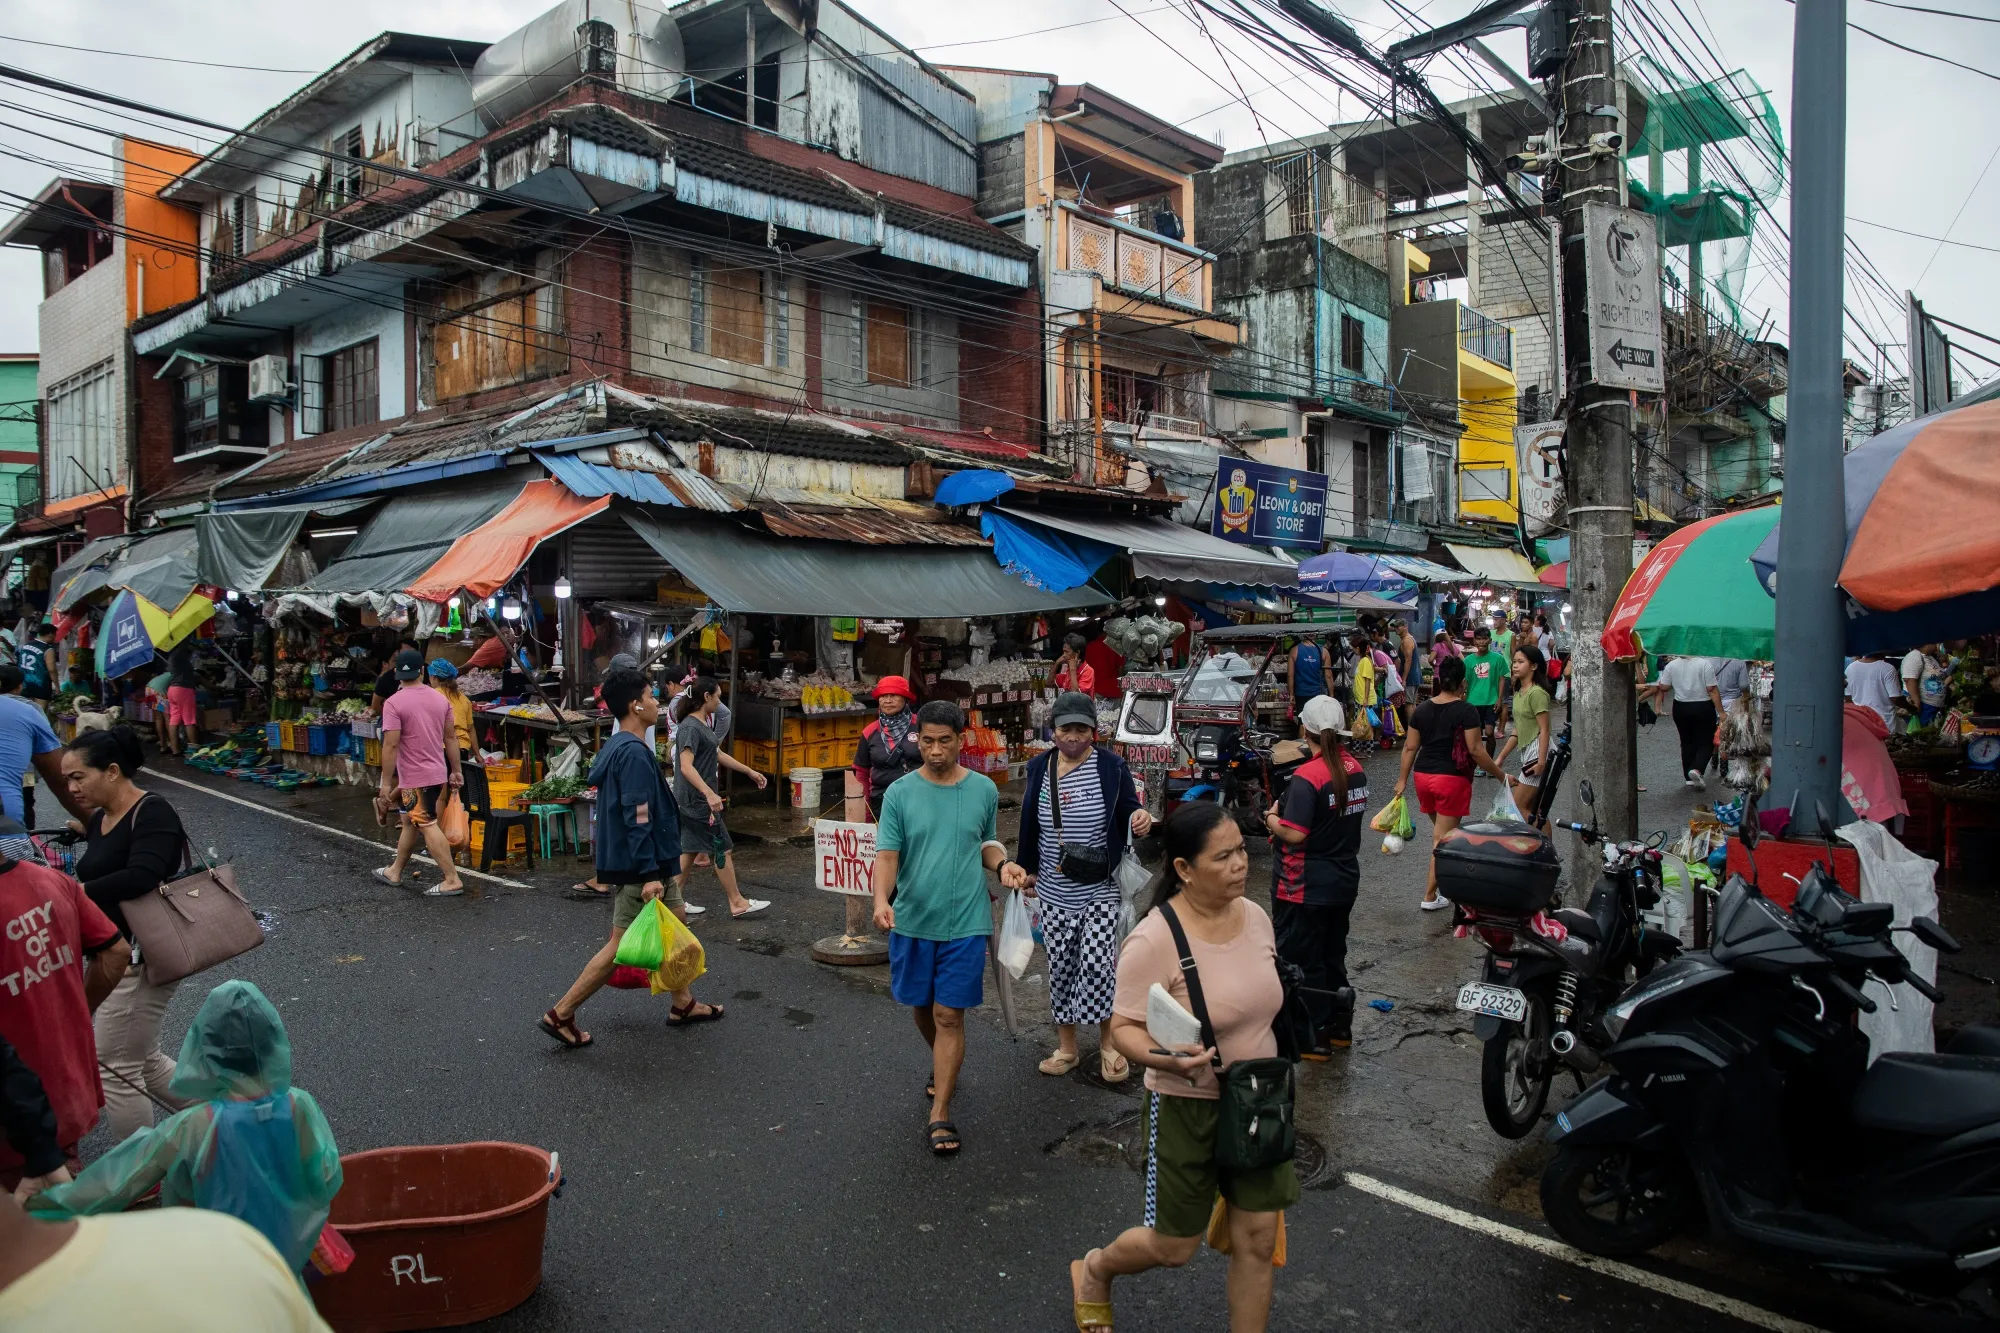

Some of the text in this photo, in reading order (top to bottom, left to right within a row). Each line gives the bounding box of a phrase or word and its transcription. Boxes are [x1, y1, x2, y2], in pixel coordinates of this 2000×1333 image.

[1614, 281, 1642, 303] NO
[1600, 302, 1631, 324] RIGHT
[1615, 348, 1651, 365] ONE WAY
[1521, 426, 1538, 434] TOW
[1539, 423, 1558, 432] AWAY
[1228, 487, 1245, 514] idol
[1526, 487, 1543, 502] NO
[1260, 495, 1322, 517] LEONY & OBET
[1276, 516, 1305, 532] STORE
[21, 653, 36, 671] 12
[1134, 677, 1151, 690] SOUTH
[1128, 745, 1174, 764] PATROL
[835, 828, 858, 859] NO
[824, 856, 874, 894] ENTRY
[6, 901, 52, 941] CITY
[26, 928, 51, 957] OF
[1461, 989, 1522, 1014] BF 62329
[1660, 1073, 1686, 1083] YAMAHA
[390, 1253, 443, 1285] RL
